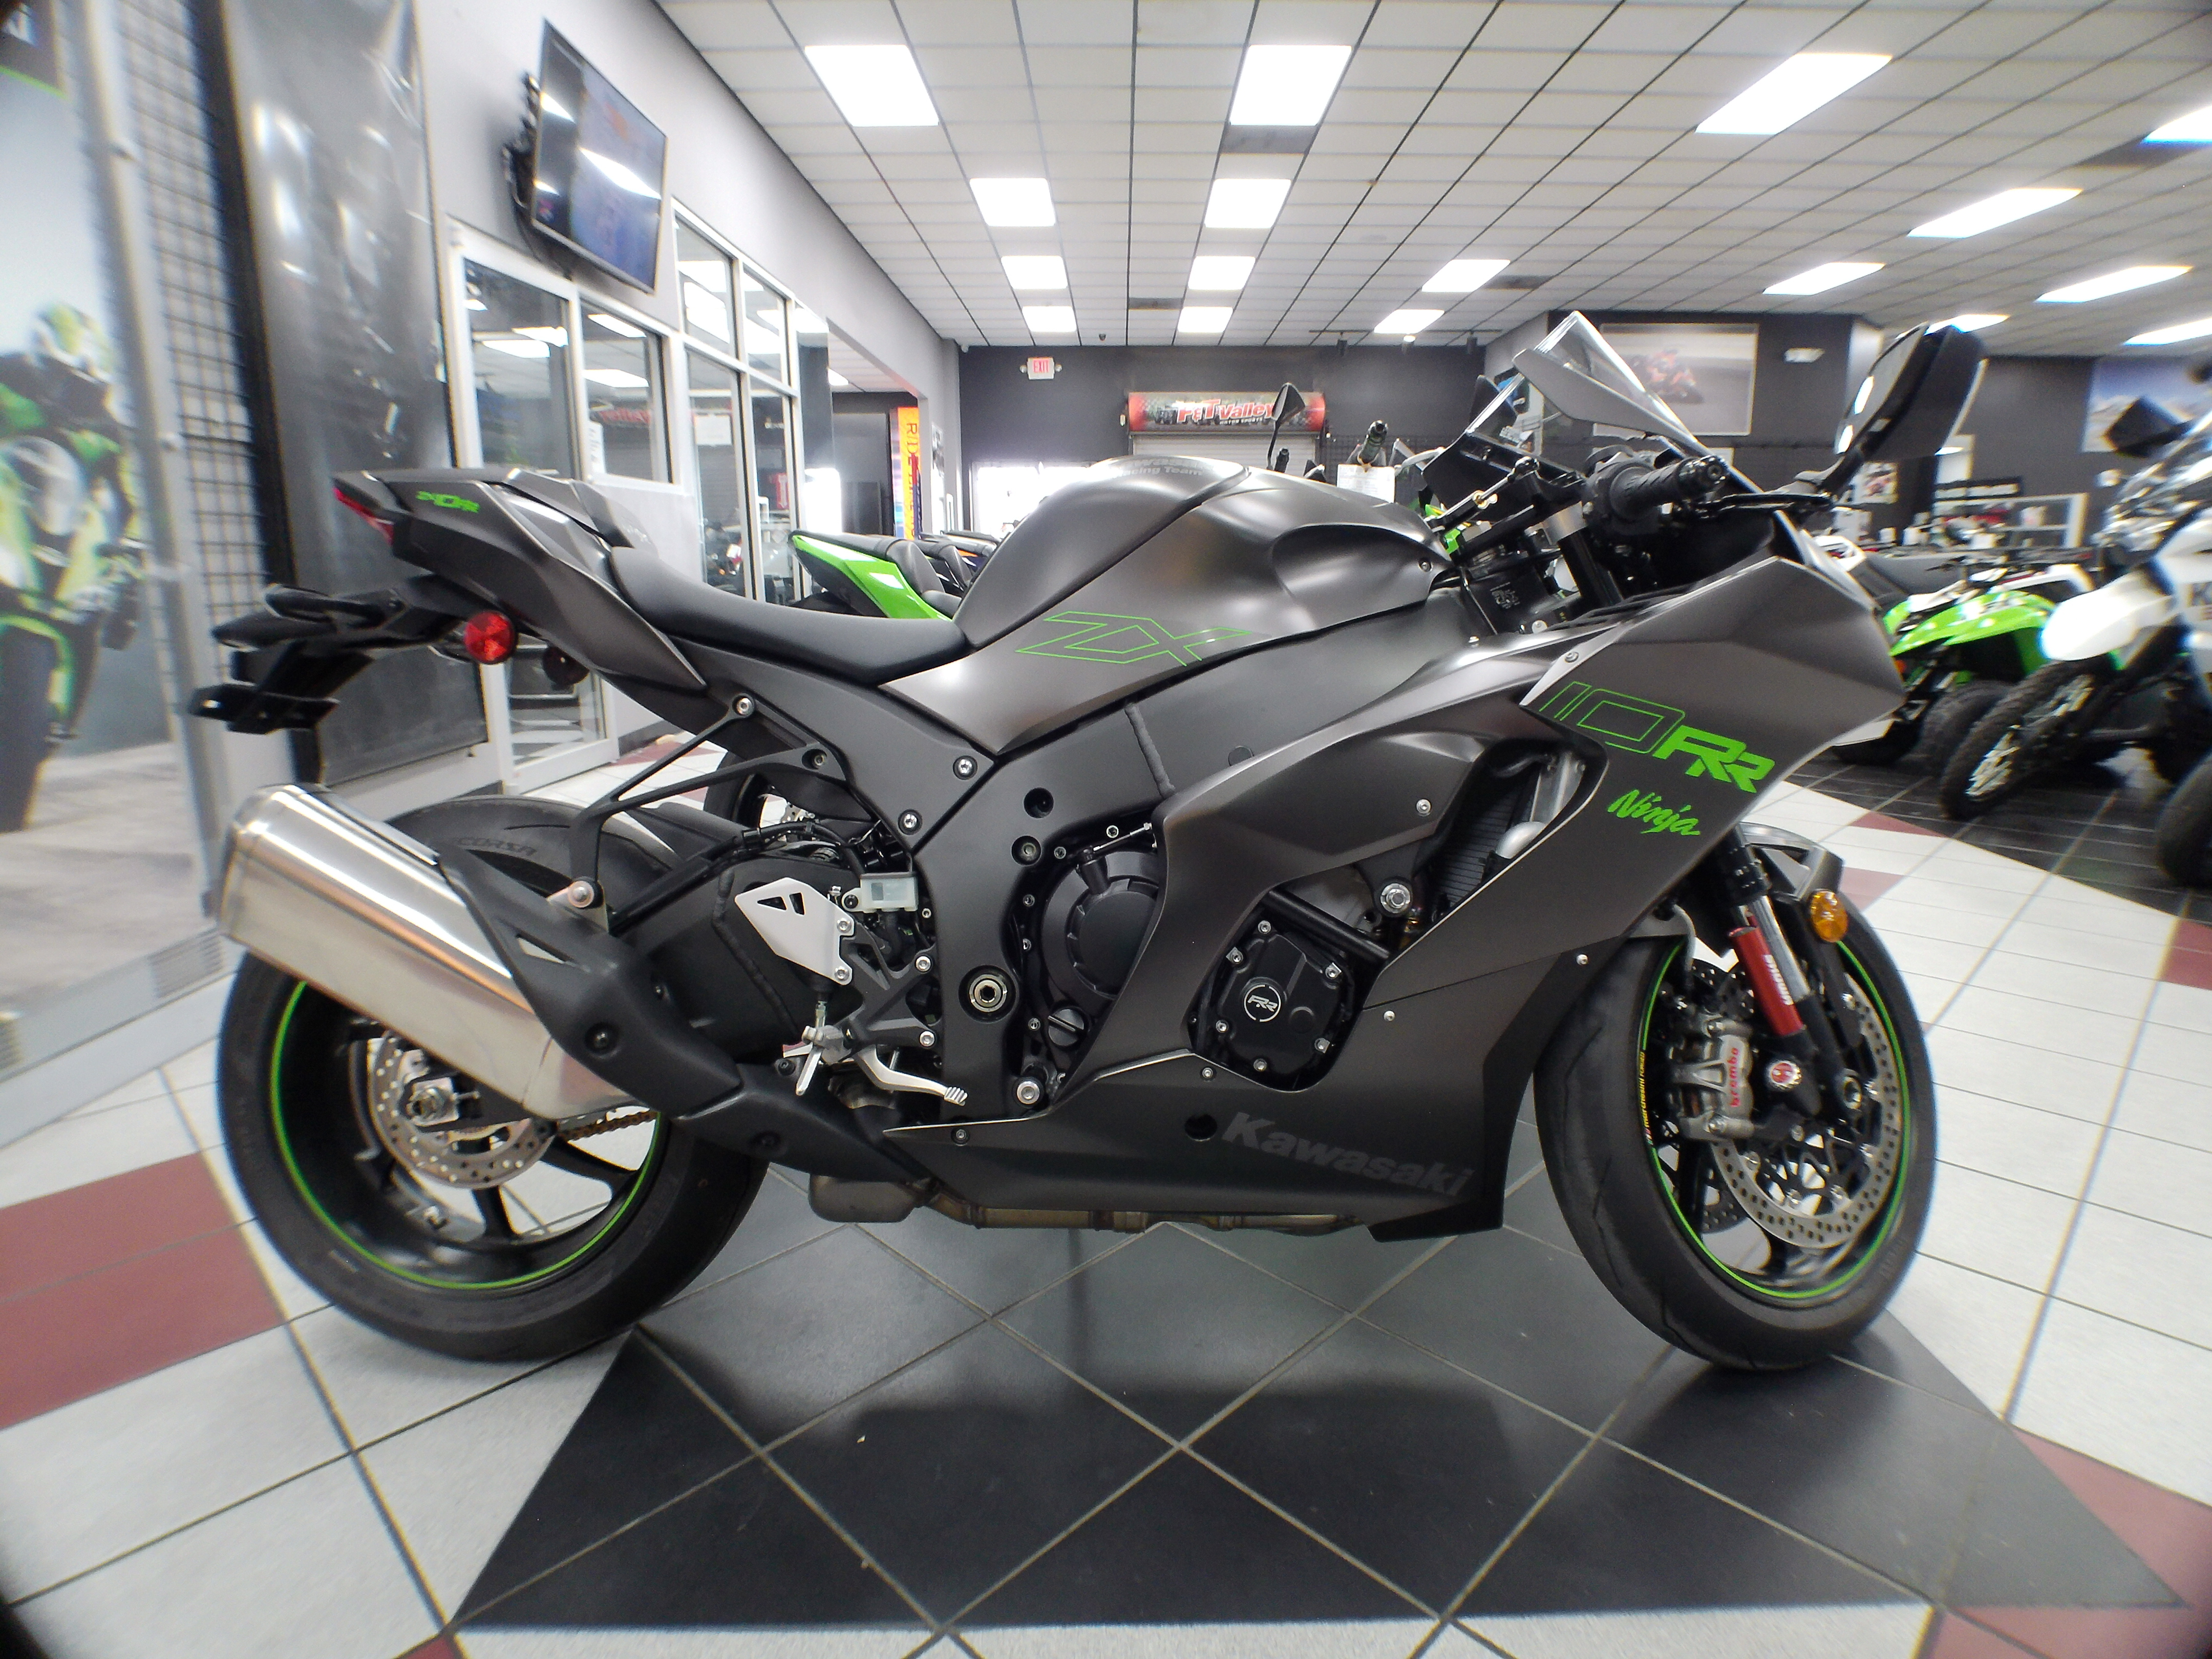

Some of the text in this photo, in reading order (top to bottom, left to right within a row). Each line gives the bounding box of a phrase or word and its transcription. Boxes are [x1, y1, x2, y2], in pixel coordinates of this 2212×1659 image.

[1033, 359, 1049, 373] EXIT
[1219, 402, 1275, 421] Valley
[1113, 466, 1203, 476] acing Team
[1607, 789, 1701, 836] Ninja
[1727, 1047, 1741, 1108] brembo
[1222, 1112, 1476, 1197] Kawasaki
